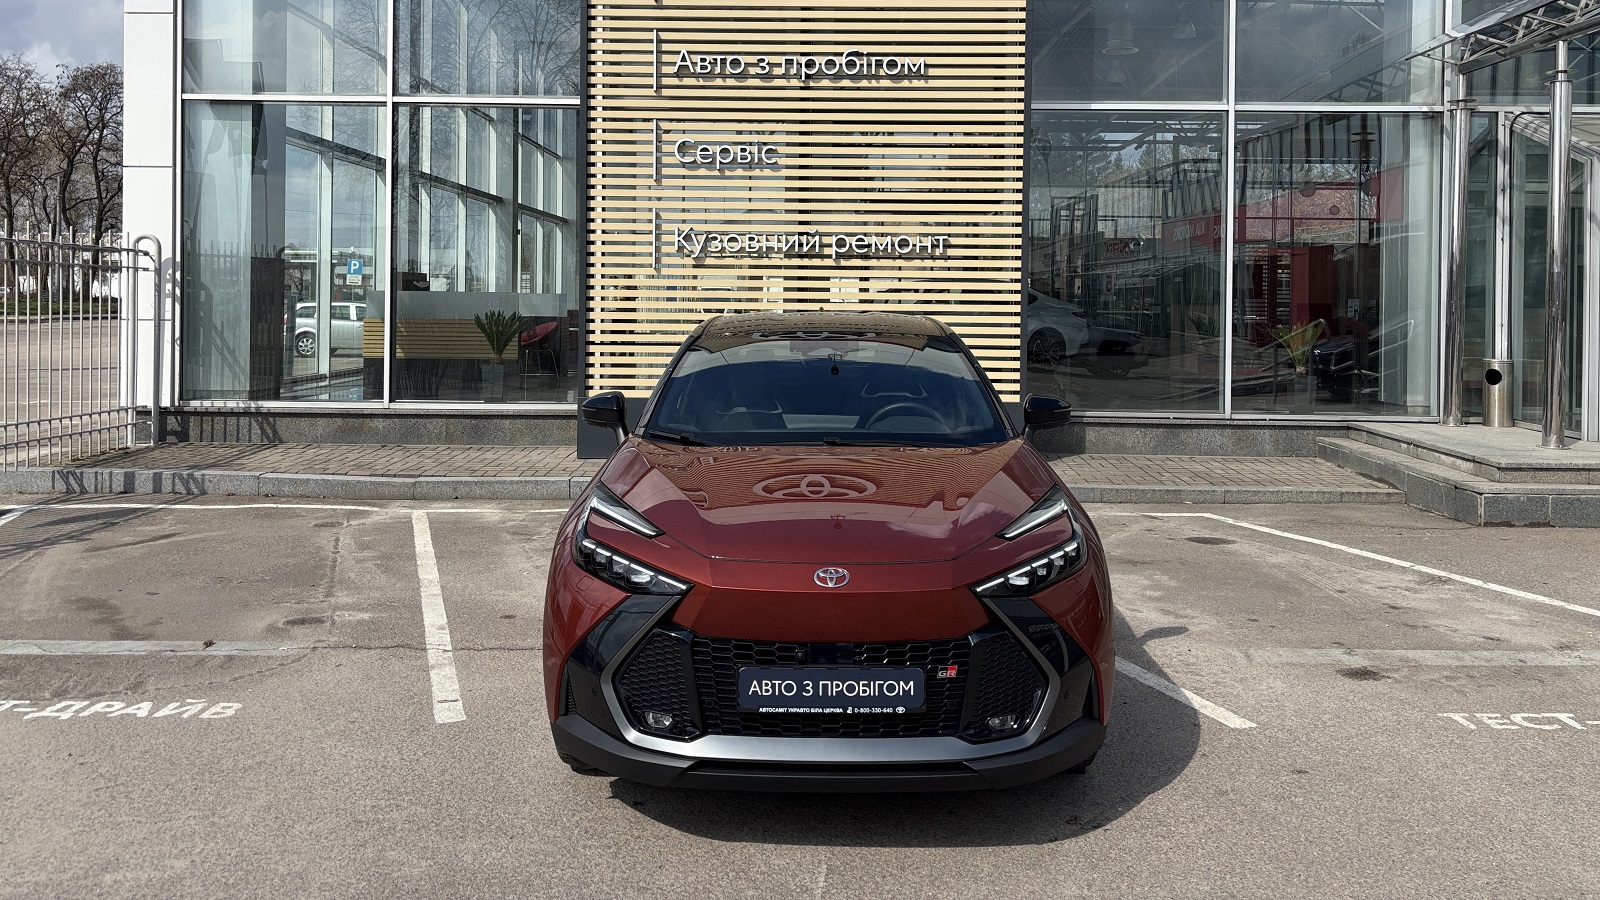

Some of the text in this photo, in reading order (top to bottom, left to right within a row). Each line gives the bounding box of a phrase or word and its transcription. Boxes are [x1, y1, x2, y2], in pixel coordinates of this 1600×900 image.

[673, 49, 926, 81] Авто з пробігом
[673, 138, 778, 169] Сервіс
[673, 227, 949, 259] Кузовний ремонт
[351, 260, 360, 273] P
[748, 680, 914, 696] АВТО З ПРОБІГОМ
